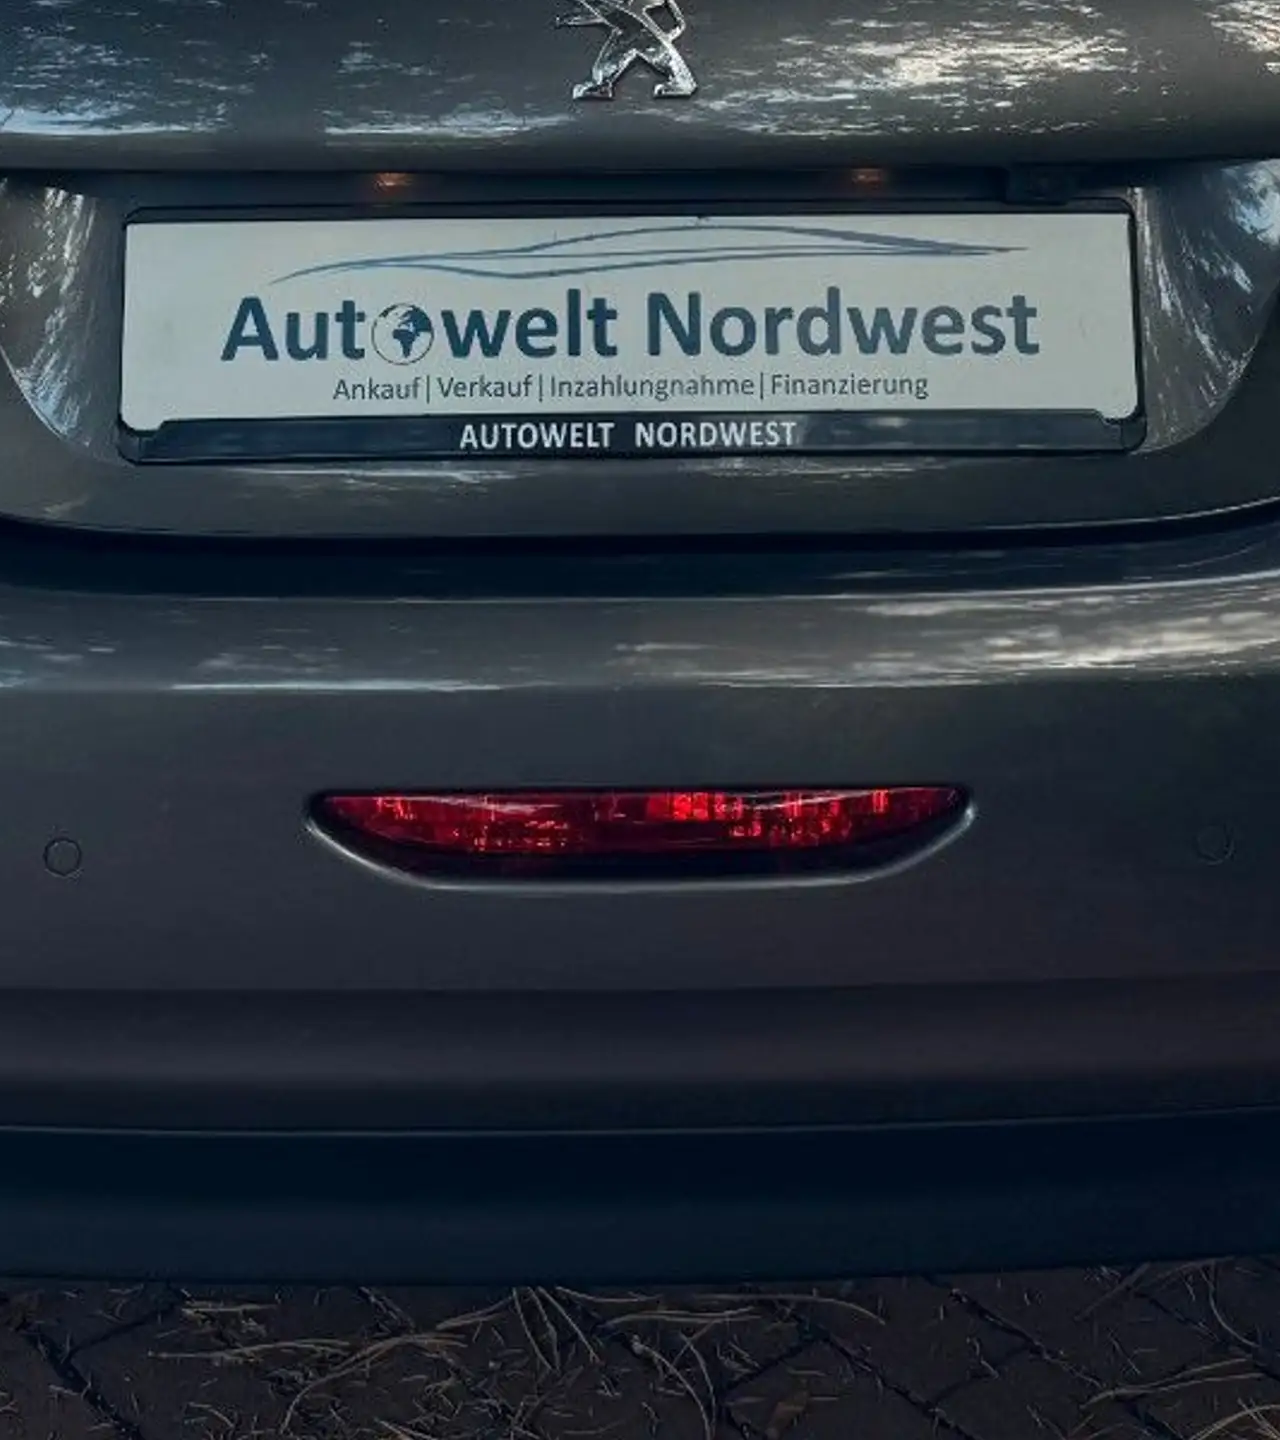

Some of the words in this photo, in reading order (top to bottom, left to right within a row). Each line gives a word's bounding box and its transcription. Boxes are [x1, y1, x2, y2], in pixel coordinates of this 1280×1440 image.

[646, 285, 1040, 357] Nordwest
[333, 376, 420, 401] Ankauf
[437, 374, 535, 400] Verkauf
[771, 373, 929, 401] Finanzierung
[459, 422, 615, 450] AUTOWELT
[634, 421, 797, 448] NORDWEST
